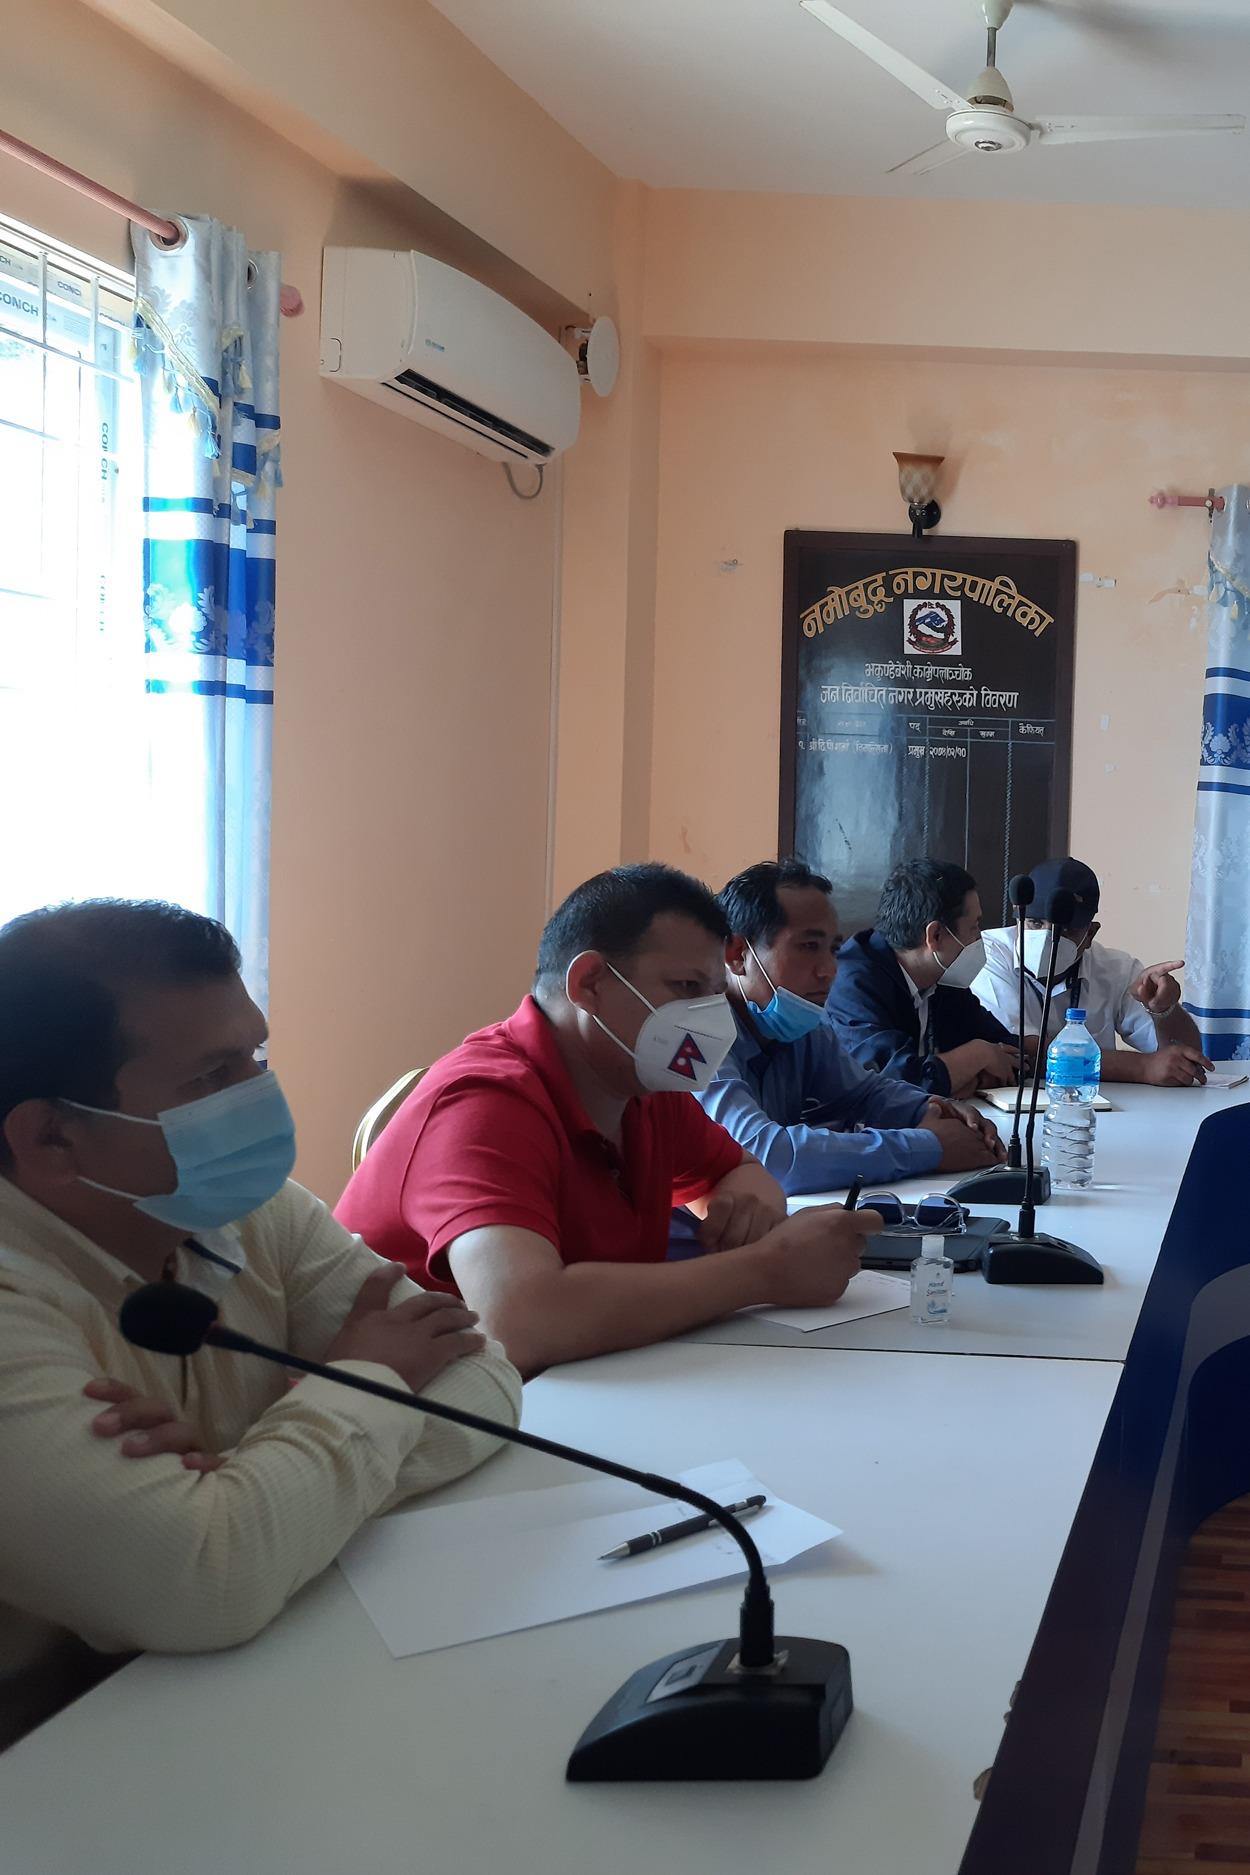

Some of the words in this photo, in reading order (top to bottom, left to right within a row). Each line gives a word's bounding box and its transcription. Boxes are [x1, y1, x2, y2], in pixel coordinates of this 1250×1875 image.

[0, 291, 39, 317] ONCH
[888, 567, 1055, 637] नगरपालिका
[888, 687, 915, 707] नगर
[981, 686, 1019, 711] विवरण
